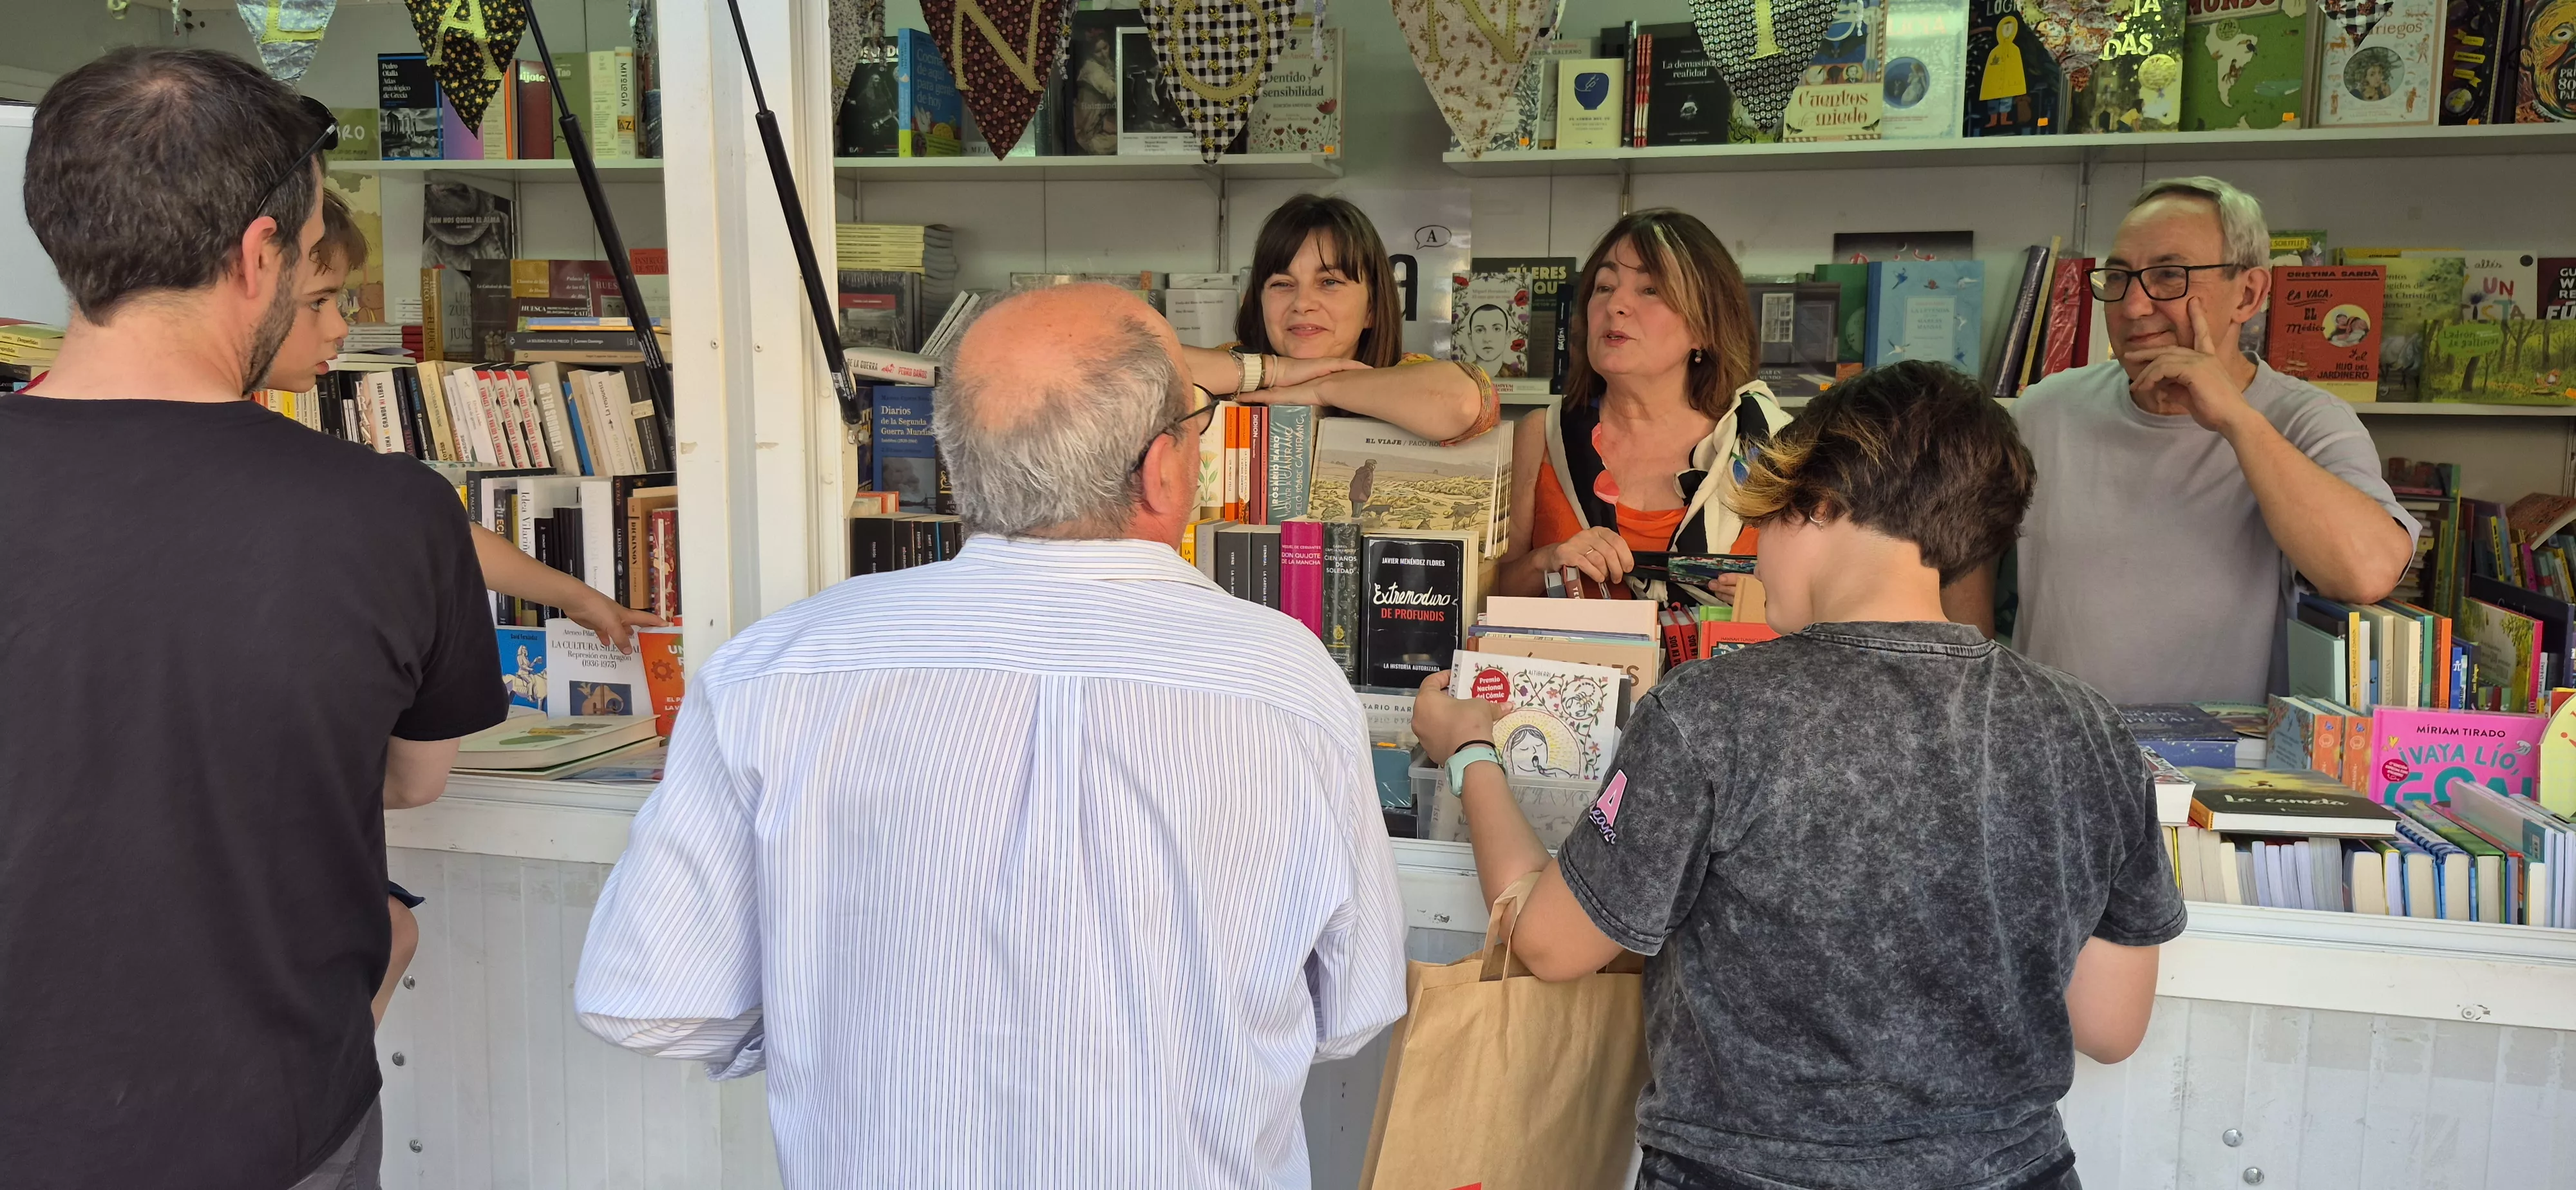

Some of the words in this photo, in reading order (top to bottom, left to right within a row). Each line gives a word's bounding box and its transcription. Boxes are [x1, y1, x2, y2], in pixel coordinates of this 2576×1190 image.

[917, 49, 943, 64] Cocina
[917, 64, 926, 75] de
[929, 66, 945, 80] aquí
[1663, 61, 1672, 69] La
[1673, 68, 1707, 78] realidad
[917, 80, 934, 91] para
[936, 82, 954, 96] gente
[1263, 86, 1323, 97] sensibilidad
[917, 93, 926, 103] de
[929, 96, 942, 109] hoy
[1816, 108, 1867, 126] miedo
[1426, 230, 1437, 243] A
[1532, 267, 1567, 279] ERES
[2483, 277, 2514, 296] UN
[2396, 290, 2438, 300] Christian
[2304, 308, 2317, 321] EL
[853, 359, 859, 368] LA
[860, 360, 878, 372] GUERRA
[898, 366, 912, 377] PEDRO
[913, 367, 928, 379] BAÑOS
[2317, 371, 2369, 379] JARDINERO
[376, 382, 385, 399] LIBRE
[598, 381, 609, 407] respuesta
[542, 394, 555, 410] DEL
[381, 405, 389, 428] GRANDE
[881, 406, 911, 415] Diarios
[489, 420, 498, 435] GUERRA
[507, 420, 516, 435] GUERRA
[526, 420, 536, 435] GUERRA
[898, 418, 927, 427] Segunda
[545, 410, 564, 453] VERDUGOS
[881, 427, 905, 435] Guerra
[1283, 427, 1294, 480] CANFRANC
[1271, 463, 1280, 505] ROSARIO
[521, 492, 530, 513] Idea
[1400, 557, 1425, 566] MENÉNDEZ
[1373, 581, 1451, 607] Extremoduro
[1381, 608, 1392, 619] DE
[1395, 609, 1444, 622] PROFUNDIS
[563, 641, 599, 651] CULTURA
[1669, 635, 1678, 647] DOS
[1688, 634, 1697, 647] DOS
[567, 650, 598, 659] Represión
[609, 652, 632, 662] Aragón
[582, 659, 617, 669] (1936-1975)
[2416, 724, 2459, 735] MÍRIAM
[2463, 728, 2506, 738] TIRADO
[1596, 769, 1628, 827] A
[2224, 793, 2257, 804] La
[2264, 794, 2349, 807] cometa
